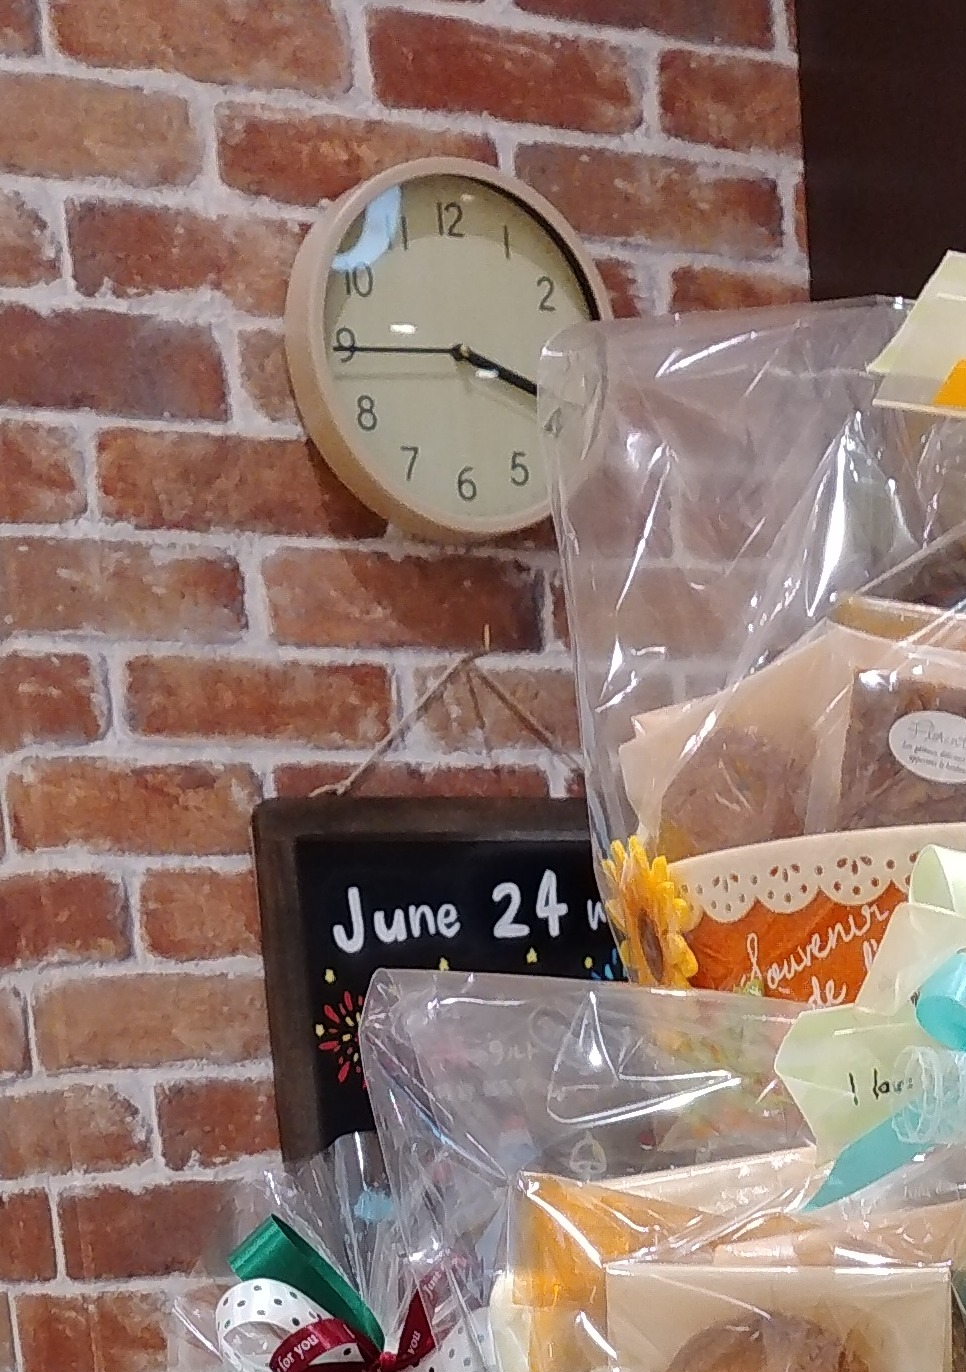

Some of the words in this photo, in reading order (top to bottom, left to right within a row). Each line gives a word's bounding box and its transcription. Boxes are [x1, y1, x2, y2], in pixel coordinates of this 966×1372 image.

[436, 201, 466, 237] 12
[503, 224, 511, 260] 1
[344, 262, 374, 298] 10
[537, 275, 556, 313] 2
[334, 326, 357, 364] 9
[356, 394, 378, 432] 8
[544, 406, 563, 438] 4
[400, 445, 420, 481] 7
[510, 451, 530, 486] 5
[457, 466, 478, 501] 6
[331, 886, 461, 955] June
[491, 868, 569, 940] 24
[293, 1333, 320, 1361] you
